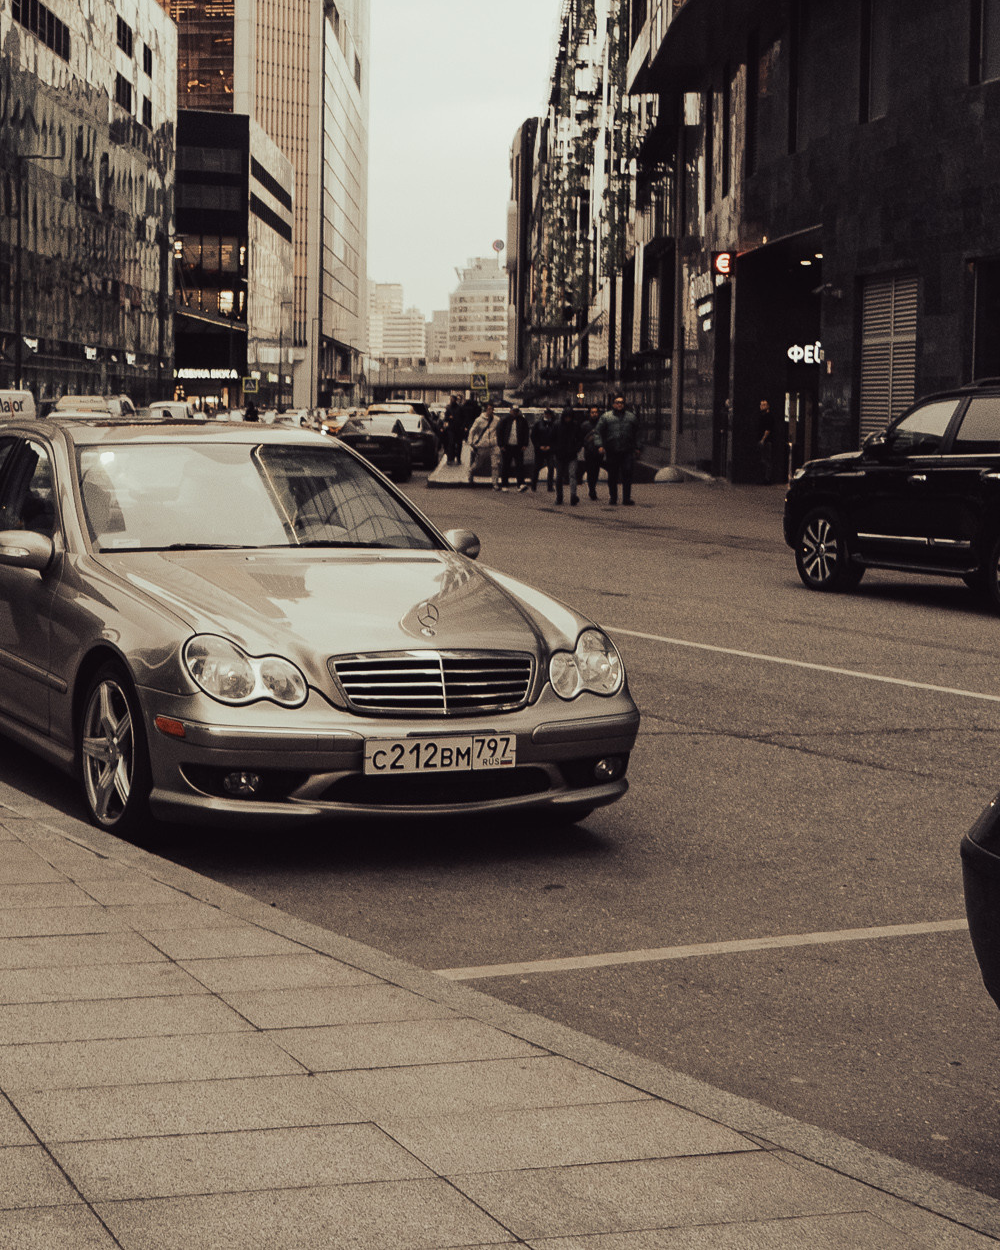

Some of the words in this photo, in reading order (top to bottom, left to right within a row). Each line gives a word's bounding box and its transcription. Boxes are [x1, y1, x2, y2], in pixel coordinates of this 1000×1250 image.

[373, 742, 471, 770] С212ВМ
[475, 737, 511, 758] 797
[482, 757, 500, 766] RUS
